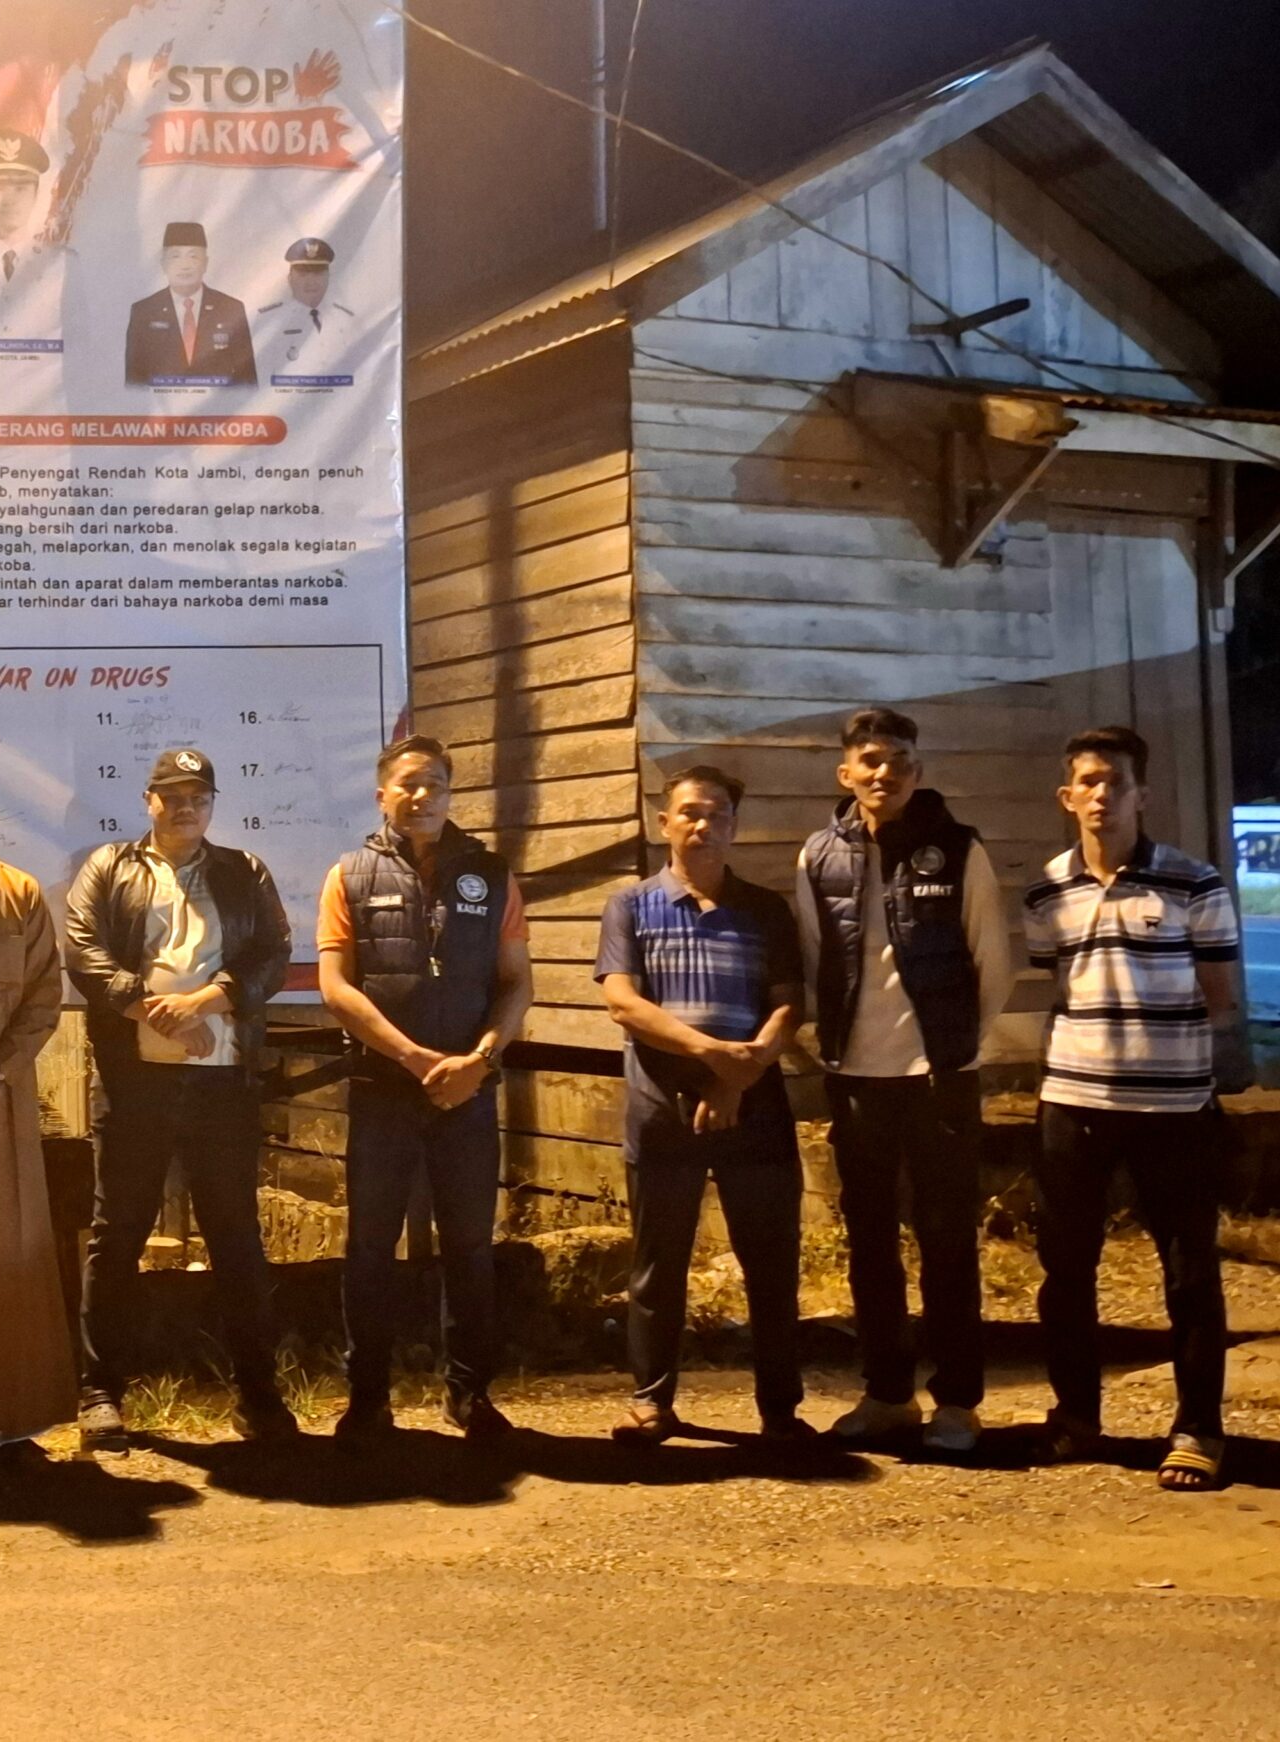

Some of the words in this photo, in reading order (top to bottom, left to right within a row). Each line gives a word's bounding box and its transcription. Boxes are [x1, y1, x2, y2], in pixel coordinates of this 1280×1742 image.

[168, 65, 289, 104] STOP
[164, 118, 329, 156] NARKOBA
[71, 422, 166, 438] MELAWAN
[174, 422, 269, 438] NARKOBA
[0, 466, 79, 482] Penyengat
[89, 467, 146, 479] Rendah
[155, 466, 188, 478] Kota
[197, 466, 246, 480] Jambi,
[255, 466, 309, 481] dengan
[318, 466, 363, 481] penuh
[18, 485, 113, 500] menyatakan:
[100, 504, 127, 516] dan
[133, 503, 209, 519] peredaran
[214, 503, 255, 518] gelap
[260, 503, 324, 515] narkoba.
[29, 522, 74, 534] bersih
[80, 522, 108, 534] dari
[114, 522, 178, 534] narkoba.
[42, 540, 134, 555] melaporkan,
[140, 540, 167, 552] dan
[173, 539, 235, 552] menolak
[241, 539, 289, 555] segala
[295, 539, 356, 554] kegiatan
[42, 578, 69, 589] dan
[75, 578, 123, 592] aparat
[128, 577, 173, 589] dalam
[179, 576, 279, 588] memberantas
[285, 576, 347, 588] narkoba.
[18, 595, 86, 608] terhindar
[91, 595, 118, 607] dari
[124, 595, 178, 610] bahaya
[184, 594, 243, 607] narkoba
[249, 594, 284, 606] demi
[290, 596, 328, 607] masa
[45, 666, 78, 689] ON
[90, 666, 171, 690] DRUGS
[97, 712, 119, 725] 11.
[239, 711, 262, 724] 16.
[98, 765, 121, 779] 12.
[241, 764, 264, 777] 17.
[99, 819, 122, 832] 13.
[243, 817, 266, 830] 18.
